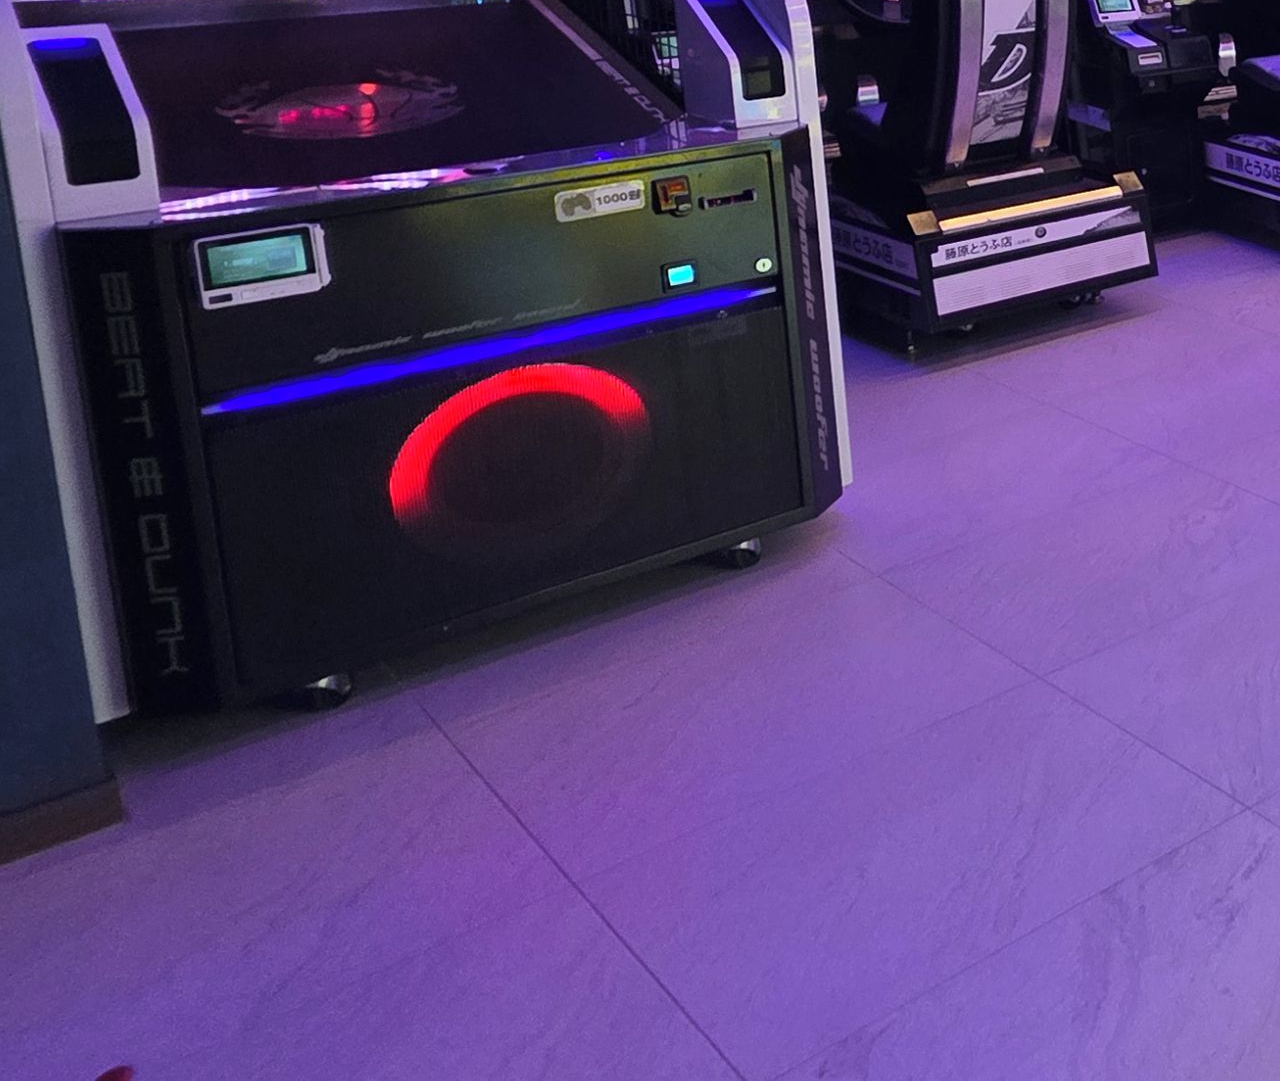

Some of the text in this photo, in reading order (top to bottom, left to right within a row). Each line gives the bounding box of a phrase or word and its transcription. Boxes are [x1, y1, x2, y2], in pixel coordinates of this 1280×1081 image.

[944, 235, 1014, 262] 藤原とうふ店
[809, 337, 828, 471] woofer
[138, 511, 192, 676] DUNK
